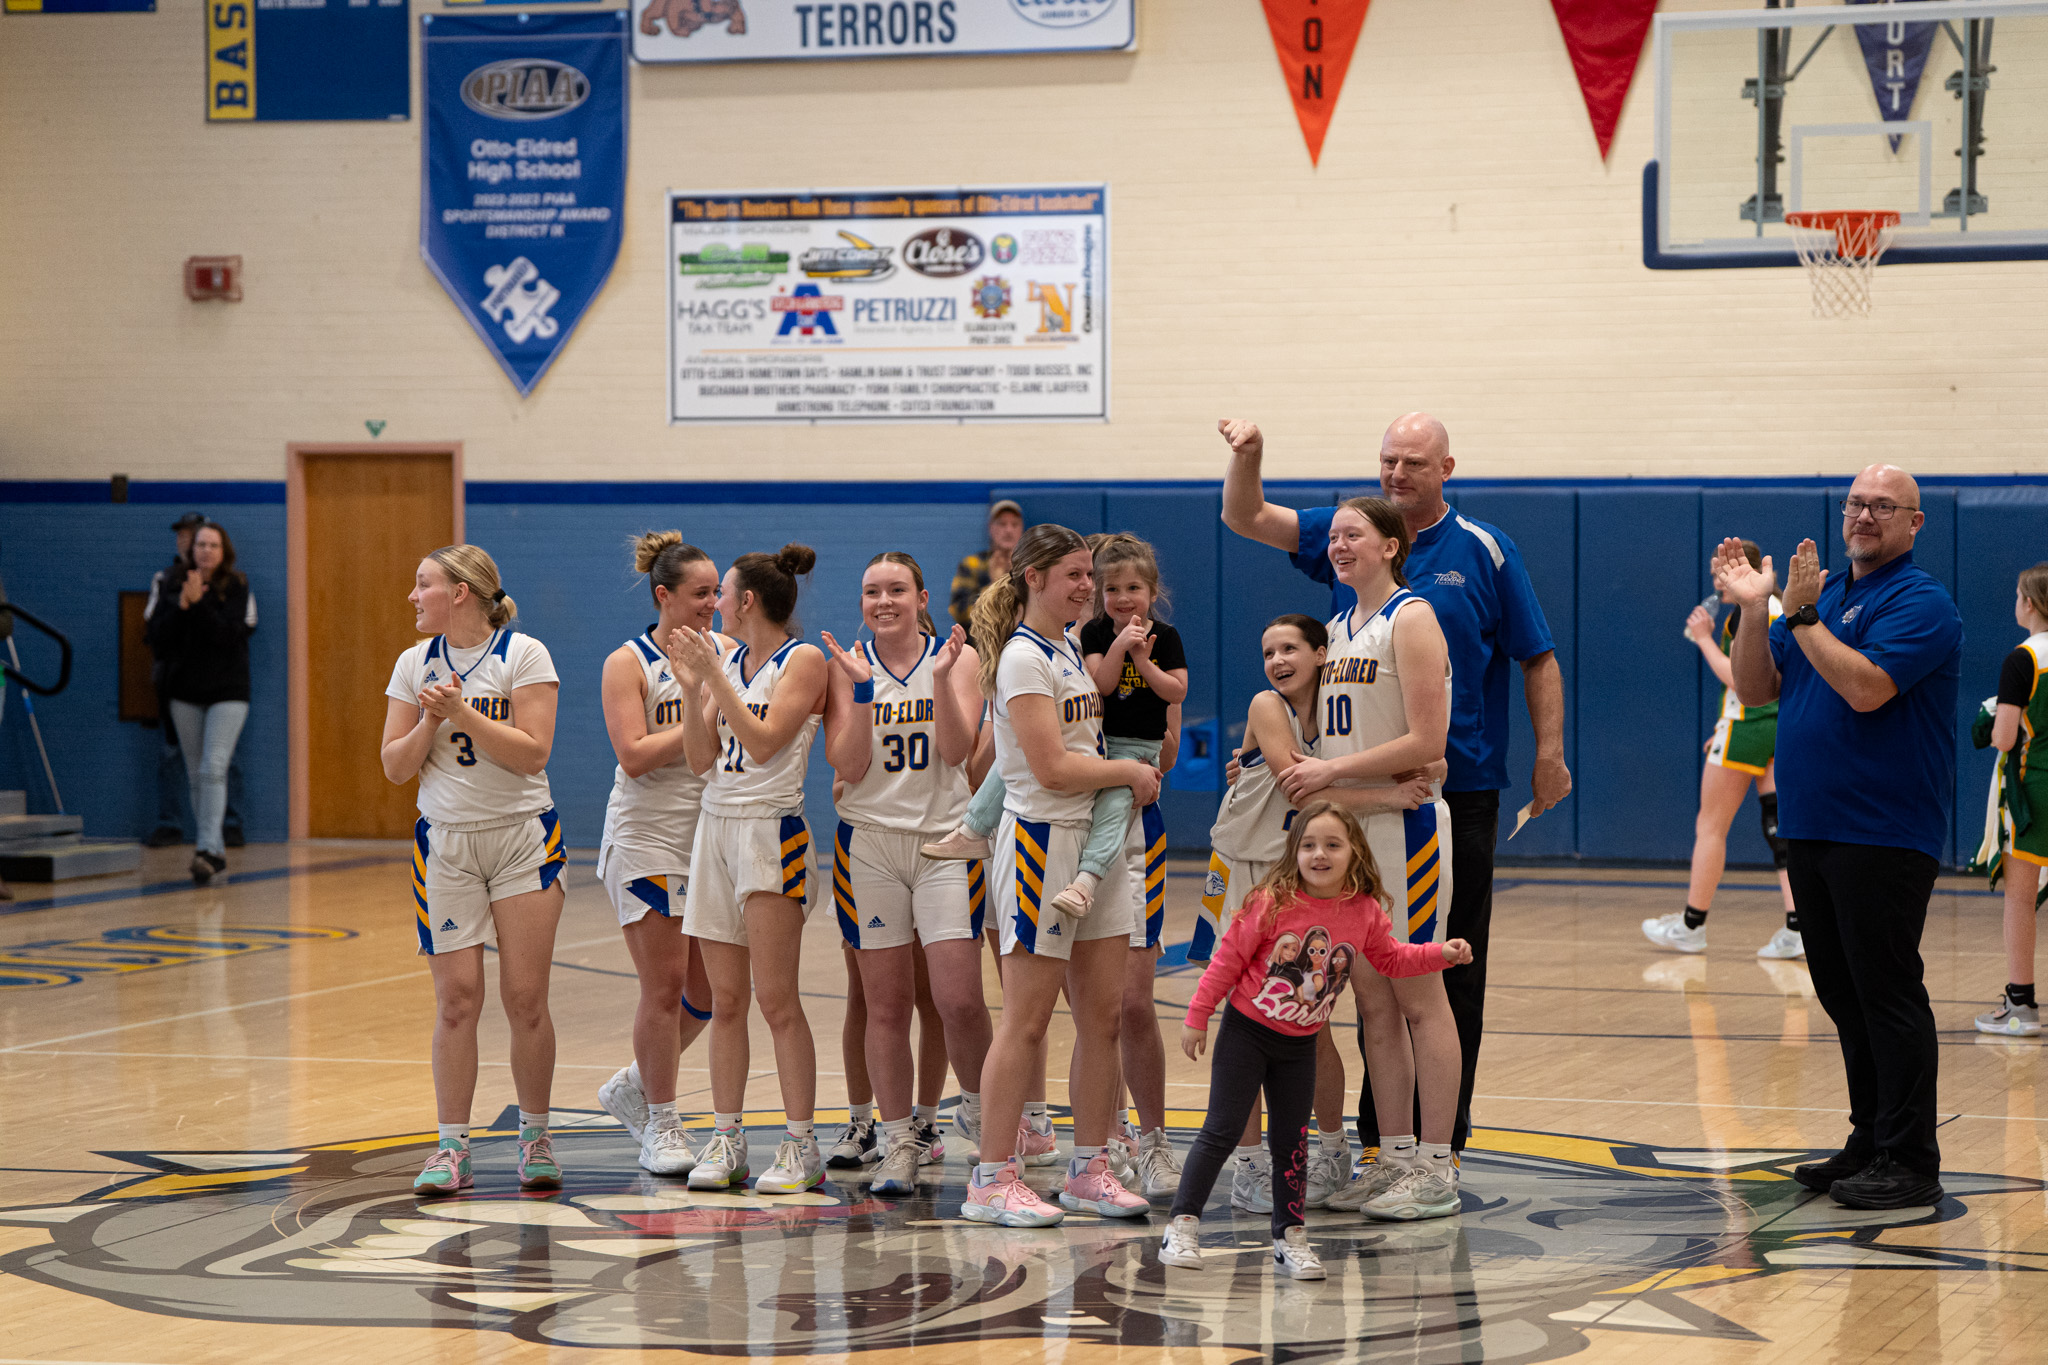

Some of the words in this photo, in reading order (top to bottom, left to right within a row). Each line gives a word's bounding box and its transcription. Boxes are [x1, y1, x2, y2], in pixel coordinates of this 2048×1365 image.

[795, 1, 957, 47] TERRORS
[1303, 0, 1322, 99] ON
[482, 68, 577, 105] PIAA
[470, 138, 578, 158] Otto-Eldred
[467, 160, 512, 184] High
[515, 160, 581, 180] School
[558, 207, 611, 221] AWARD
[485, 224, 549, 239] DISTRICT
[903, 238, 980, 264] Close's
[678, 298, 767, 319] HAGG'S
[853, 297, 957, 322] PETRUZZI
[1321, 657, 1379, 686] TO-ELDRED
[656, 698, 683, 725] OTT
[873, 698, 935, 726] TO-ELDR
[1326, 693, 1352, 736] 10
[450, 732, 478, 767] 3
[724, 736, 745, 773] 11
[882, 732, 929, 773] 30
